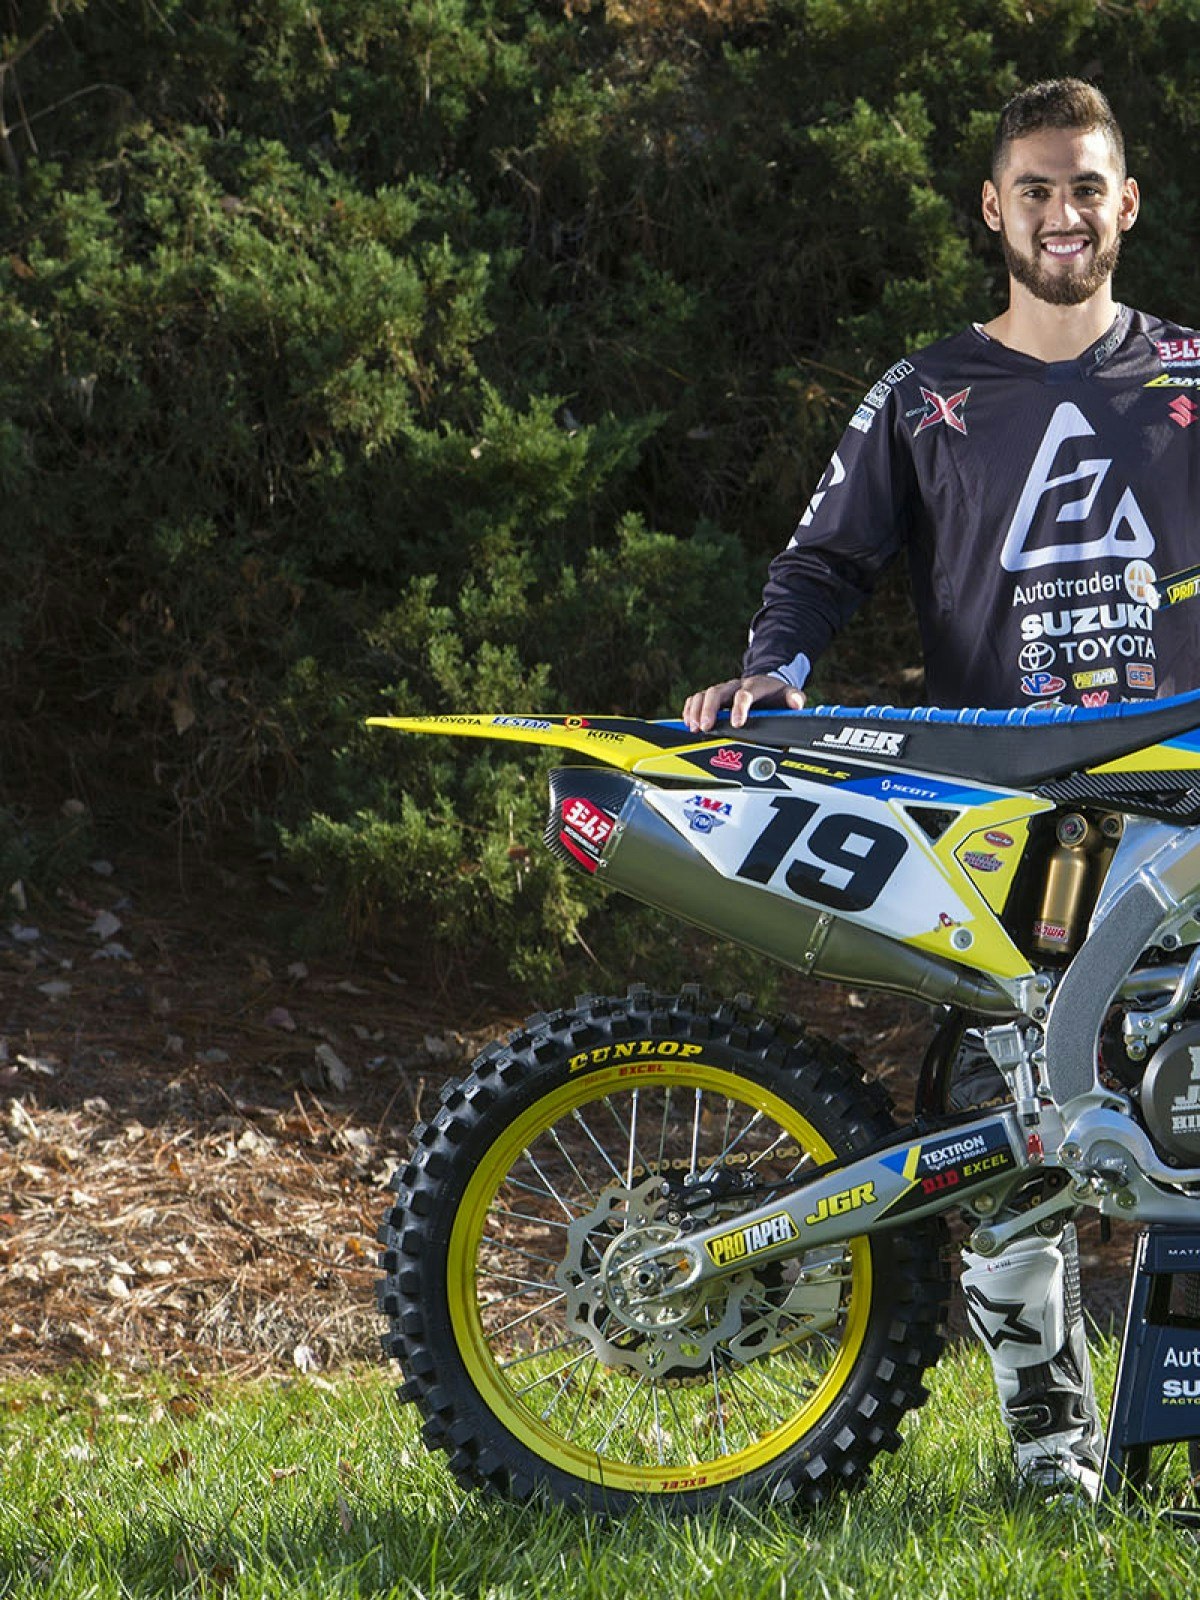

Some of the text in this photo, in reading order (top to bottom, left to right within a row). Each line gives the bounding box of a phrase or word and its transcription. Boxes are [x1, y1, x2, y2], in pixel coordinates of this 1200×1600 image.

[1012, 571, 1123, 607] Autotrader
[1020, 602, 1153, 642] SUZUKI
[1058, 634, 1157, 664] TOYOTA
[1129, 669, 1153, 683] GET
[433, 716, 482, 727] TOYOTA
[823, 726, 906, 753] JGR
[684, 794, 733, 816] AMA
[890, 783, 940, 799] SCOTT
[736, 795, 909, 913] 19
[567, 1040, 704, 1074] DUNLOP
[920, 1134, 986, 1166] TEXTRON
[962, 1152, 1009, 1178] EXCEL
[805, 1180, 878, 1227] JGR
[711, 1214, 793, 1266] PROTAPER
